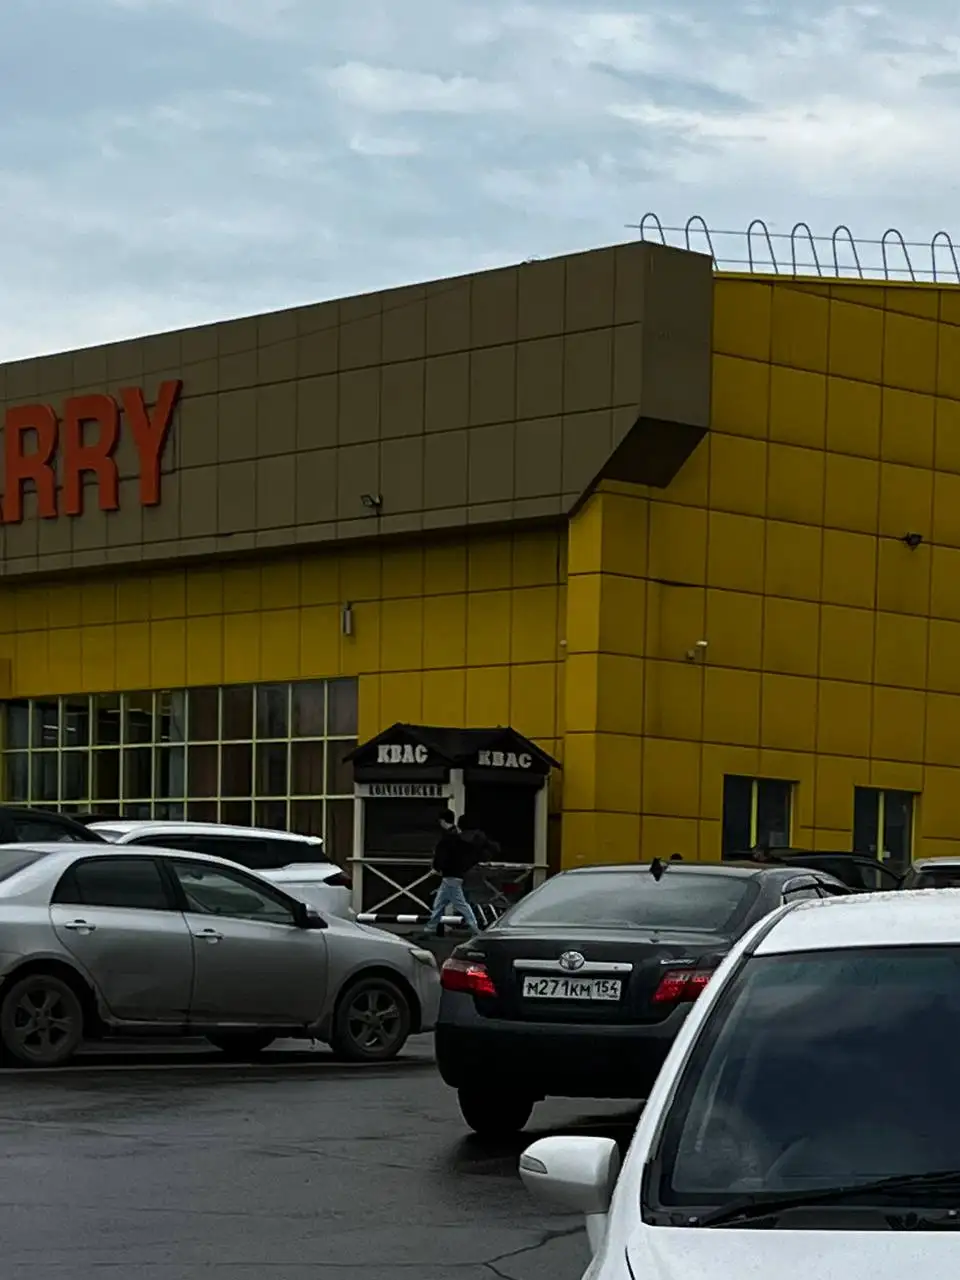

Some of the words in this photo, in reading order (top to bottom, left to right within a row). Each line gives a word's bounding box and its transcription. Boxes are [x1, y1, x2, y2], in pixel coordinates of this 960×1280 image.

[2, 379, 183, 525] RRY
[376, 743, 429, 764] КВАС
[477, 749, 533, 769] КВАС
[595, 980, 618, 995] 154
